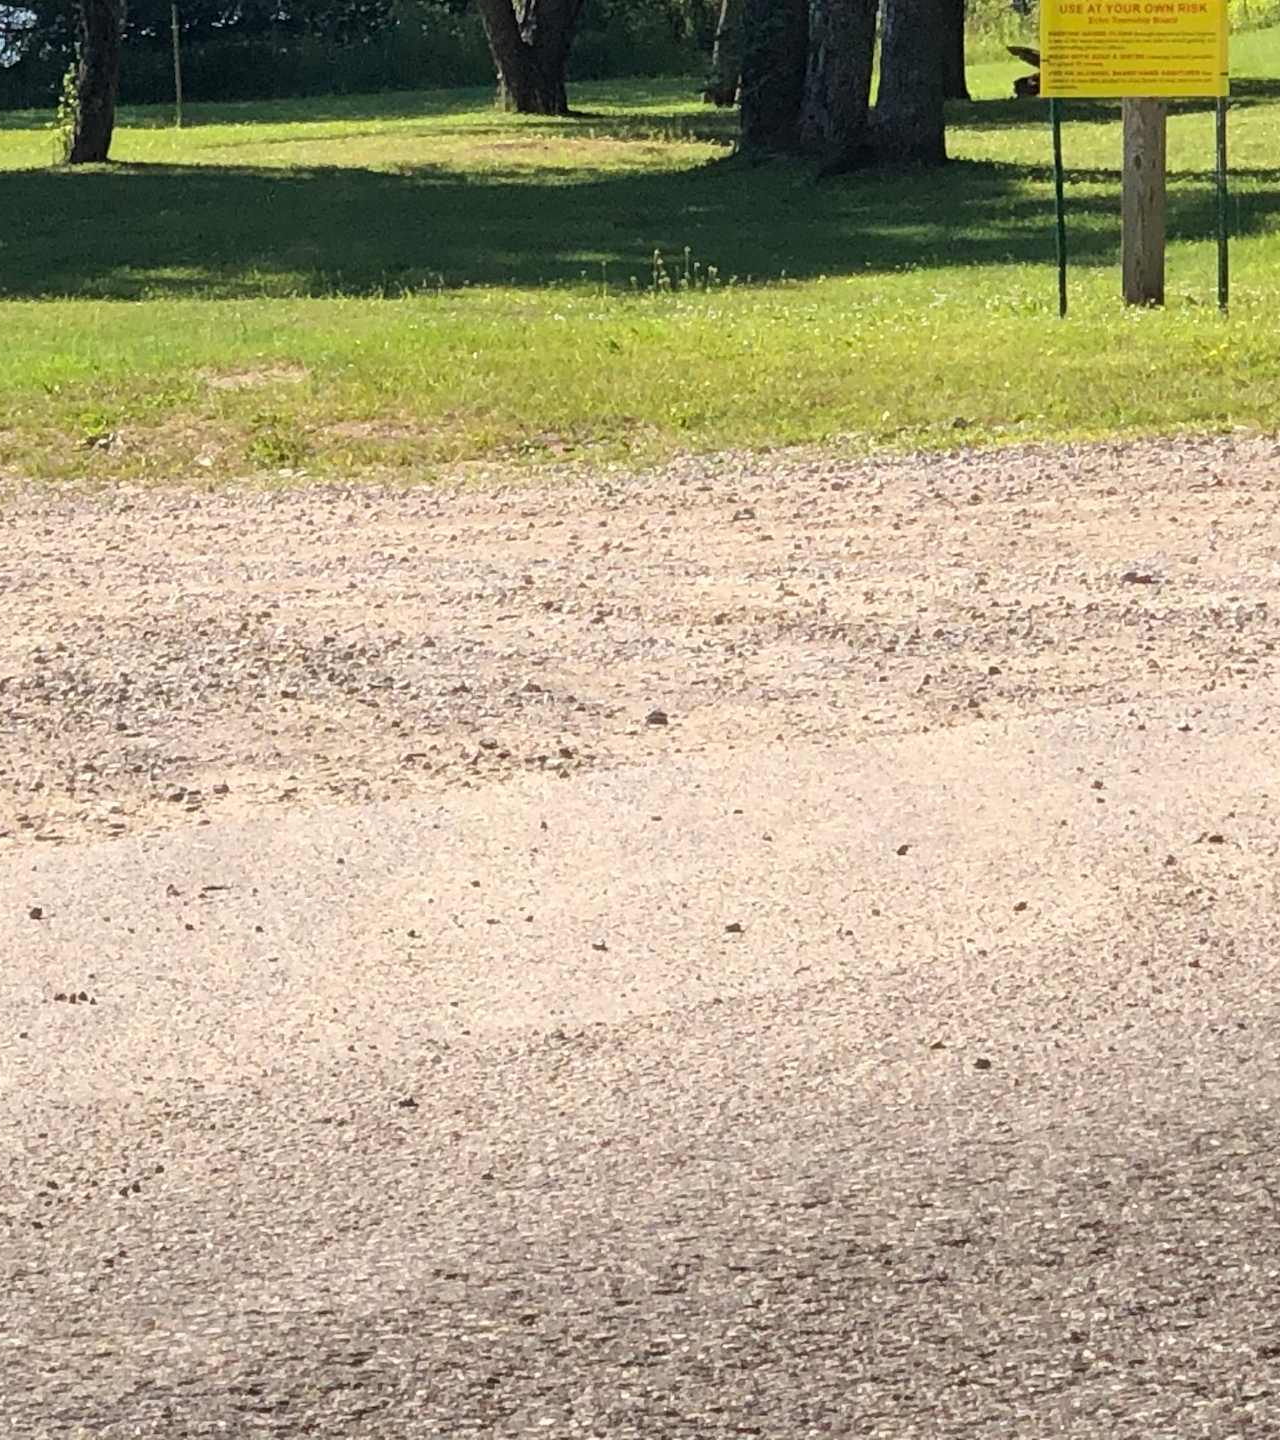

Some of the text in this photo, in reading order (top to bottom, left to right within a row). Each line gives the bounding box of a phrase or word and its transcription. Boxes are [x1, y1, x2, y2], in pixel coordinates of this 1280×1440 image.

[1059, 2, 1208, 15] USE AT YOUR OWN RISK
